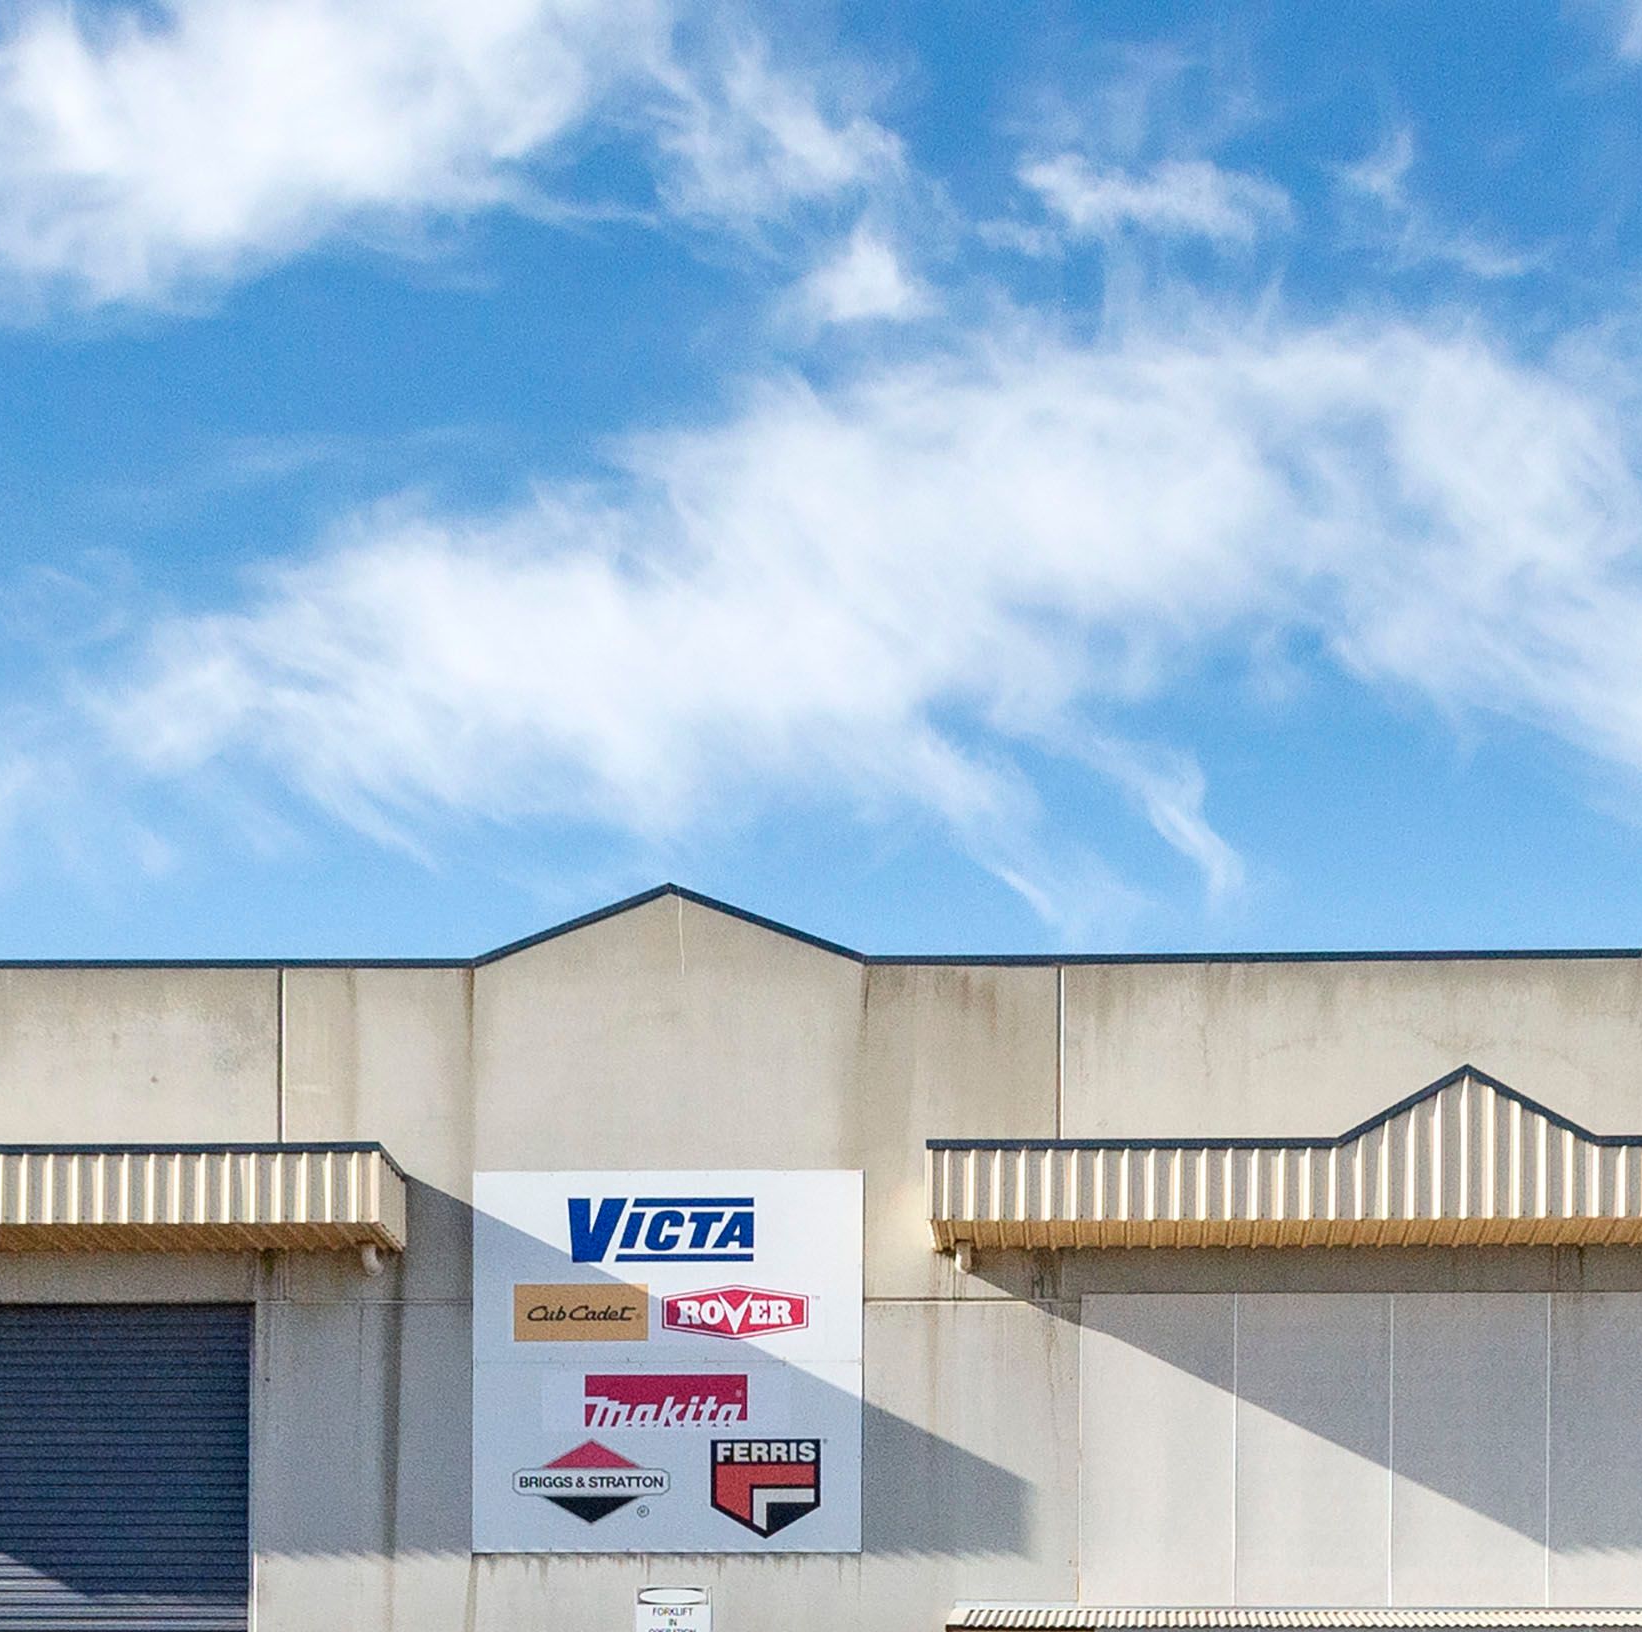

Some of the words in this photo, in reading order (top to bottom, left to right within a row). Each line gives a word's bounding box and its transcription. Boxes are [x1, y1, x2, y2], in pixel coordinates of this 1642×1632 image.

[567, 1197, 755, 1262] VICTA
[527, 1304, 565, 1322] Cub
[569, 1304, 636, 1322] Cadet
[676, 1295, 793, 1334] ROVER
[717, 1442, 817, 1463] FERRIS
[519, 1476, 572, 1489] BRIGGS
[575, 1476, 586, 1489] &
[588, 1476, 665, 1489] STRATTON
[653, 1608, 693, 1616] FORKLIFT
